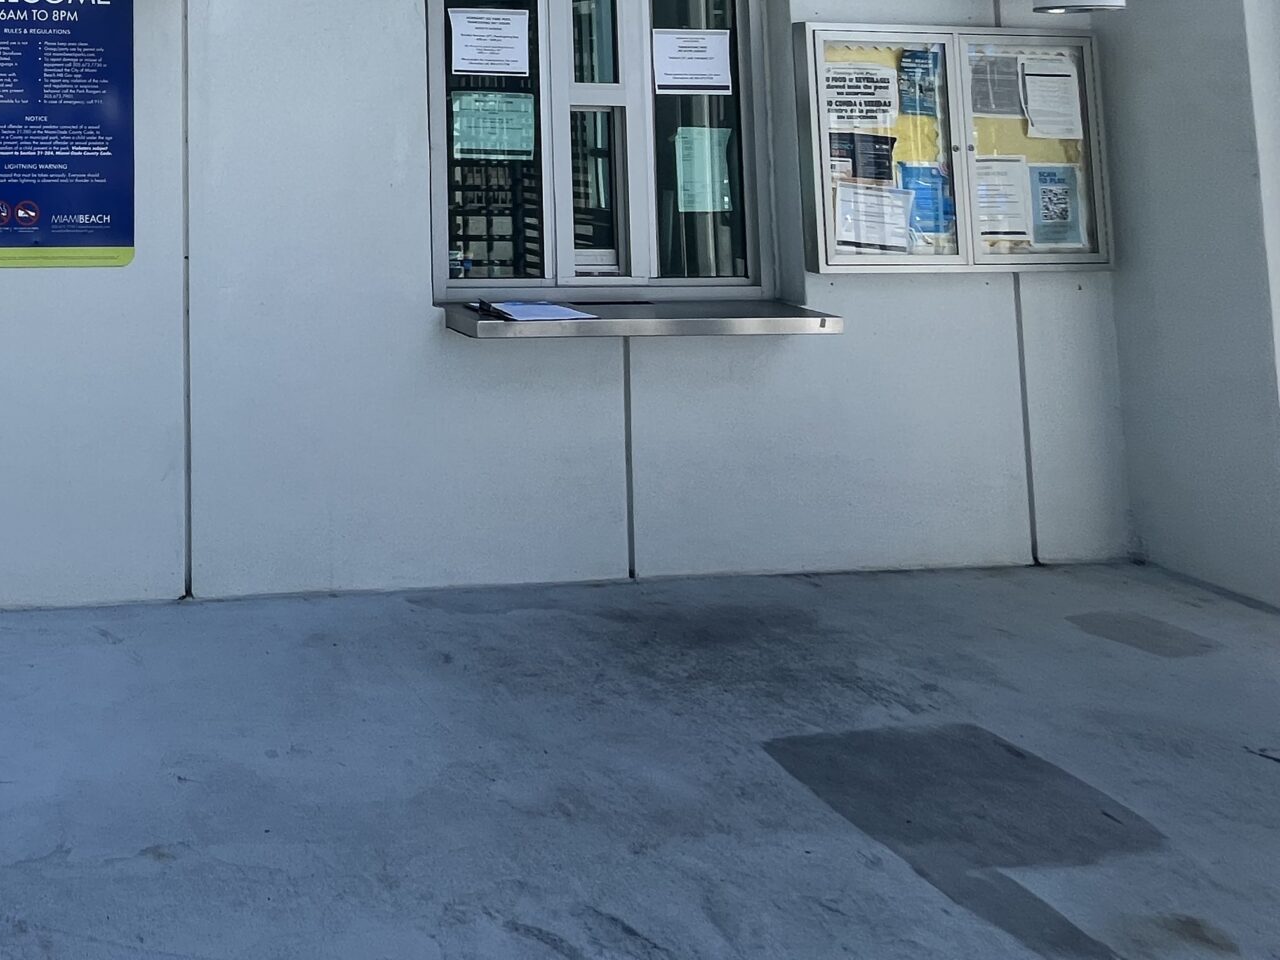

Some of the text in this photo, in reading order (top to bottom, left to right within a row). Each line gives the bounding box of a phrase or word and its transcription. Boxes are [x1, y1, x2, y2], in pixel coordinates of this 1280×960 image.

[0, 9, 28, 21] 6AM
[32, 9, 48, 21] TO
[52, 9, 79, 22] 8PM
[51, 215, 110, 224] MIAMIBEACH
